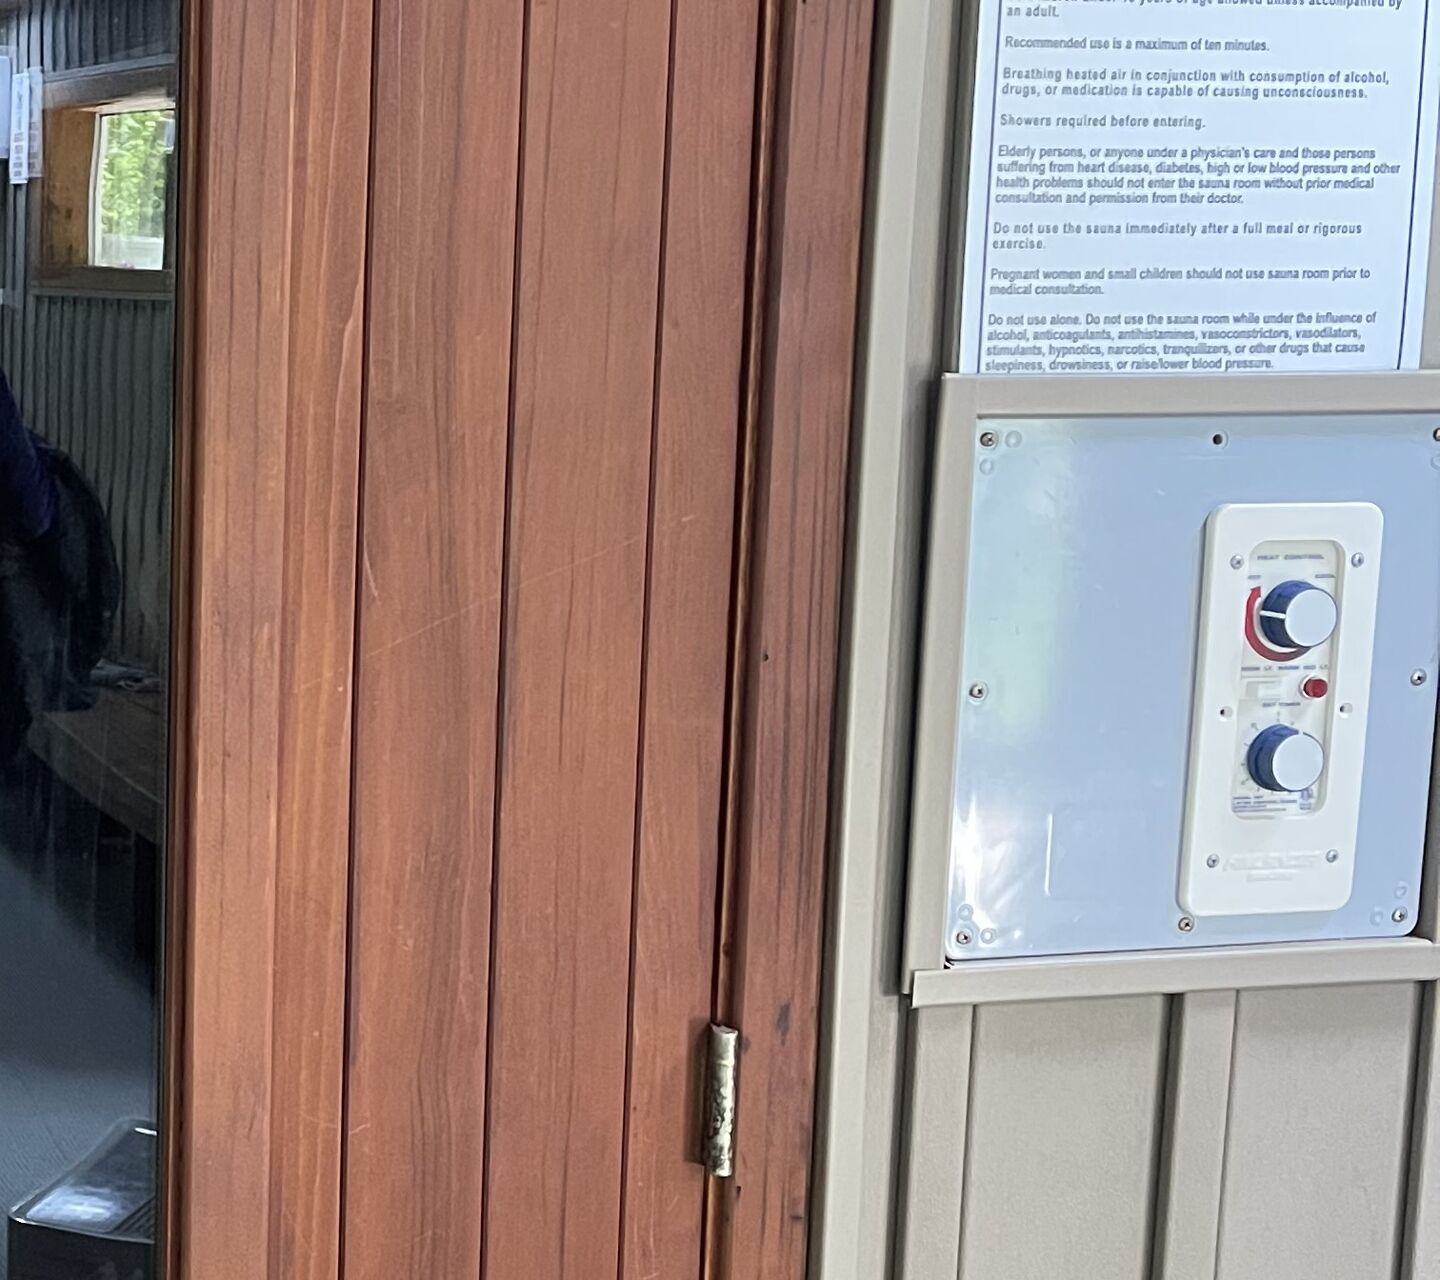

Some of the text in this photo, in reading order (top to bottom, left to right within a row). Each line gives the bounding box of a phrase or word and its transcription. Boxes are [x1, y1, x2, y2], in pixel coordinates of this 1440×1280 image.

[1006, 7, 1023, 16] an
[1005, 35, 1087, 48] Recommended
[1089, 40, 1110, 49] use
[1112, 37, 1123, 49] is
[1124, 40, 1133, 49] a
[1135, 38, 1188, 49] maximum
[1190, 38, 1202, 50] of
[1204, 39, 1222, 50] ten
[1003, 67, 1062, 82] Breathing
[1066, 68, 1108, 80] heated
[1110, 68, 1127, 80] air
[1130, 68, 1142, 80] in
[1145, 68, 1216, 84] conjunction
[1219, 70, 1245, 81] with
[1248, 71, 1325, 85] consumption
[1328, 71, 1340, 82] of
[1044, 85, 1058, 95] or
[1061, 83, 1129, 95] medication
[1132, 84, 1143, 96] is
[1145, 84, 1194, 98] capable
[1197, 84, 1209, 96] of
[1212, 86, 1259, 99] causing
[1000, 114, 1053, 126] Showers
[1055, 114, 1107, 128] required
[1110, 115, 1150, 126] before
[998, 145, 1036, 160] Elderly
[1088, 148, 1101, 157] or
[1104, 148, 1144, 161] anyone
[1147, 147, 1179, 157] under
[1181, 149, 1188, 157] a
[1190, 146, 1250, 161] physician's
[1253, 149, 1276, 158] care
[1278, 147, 1299, 158] and
[1301, 147, 1331, 158] those
[1333, 150, 1376, 161] persons
[993, 222, 1362, 236] Do not use the sauna immediately after a full meal or rigorous
